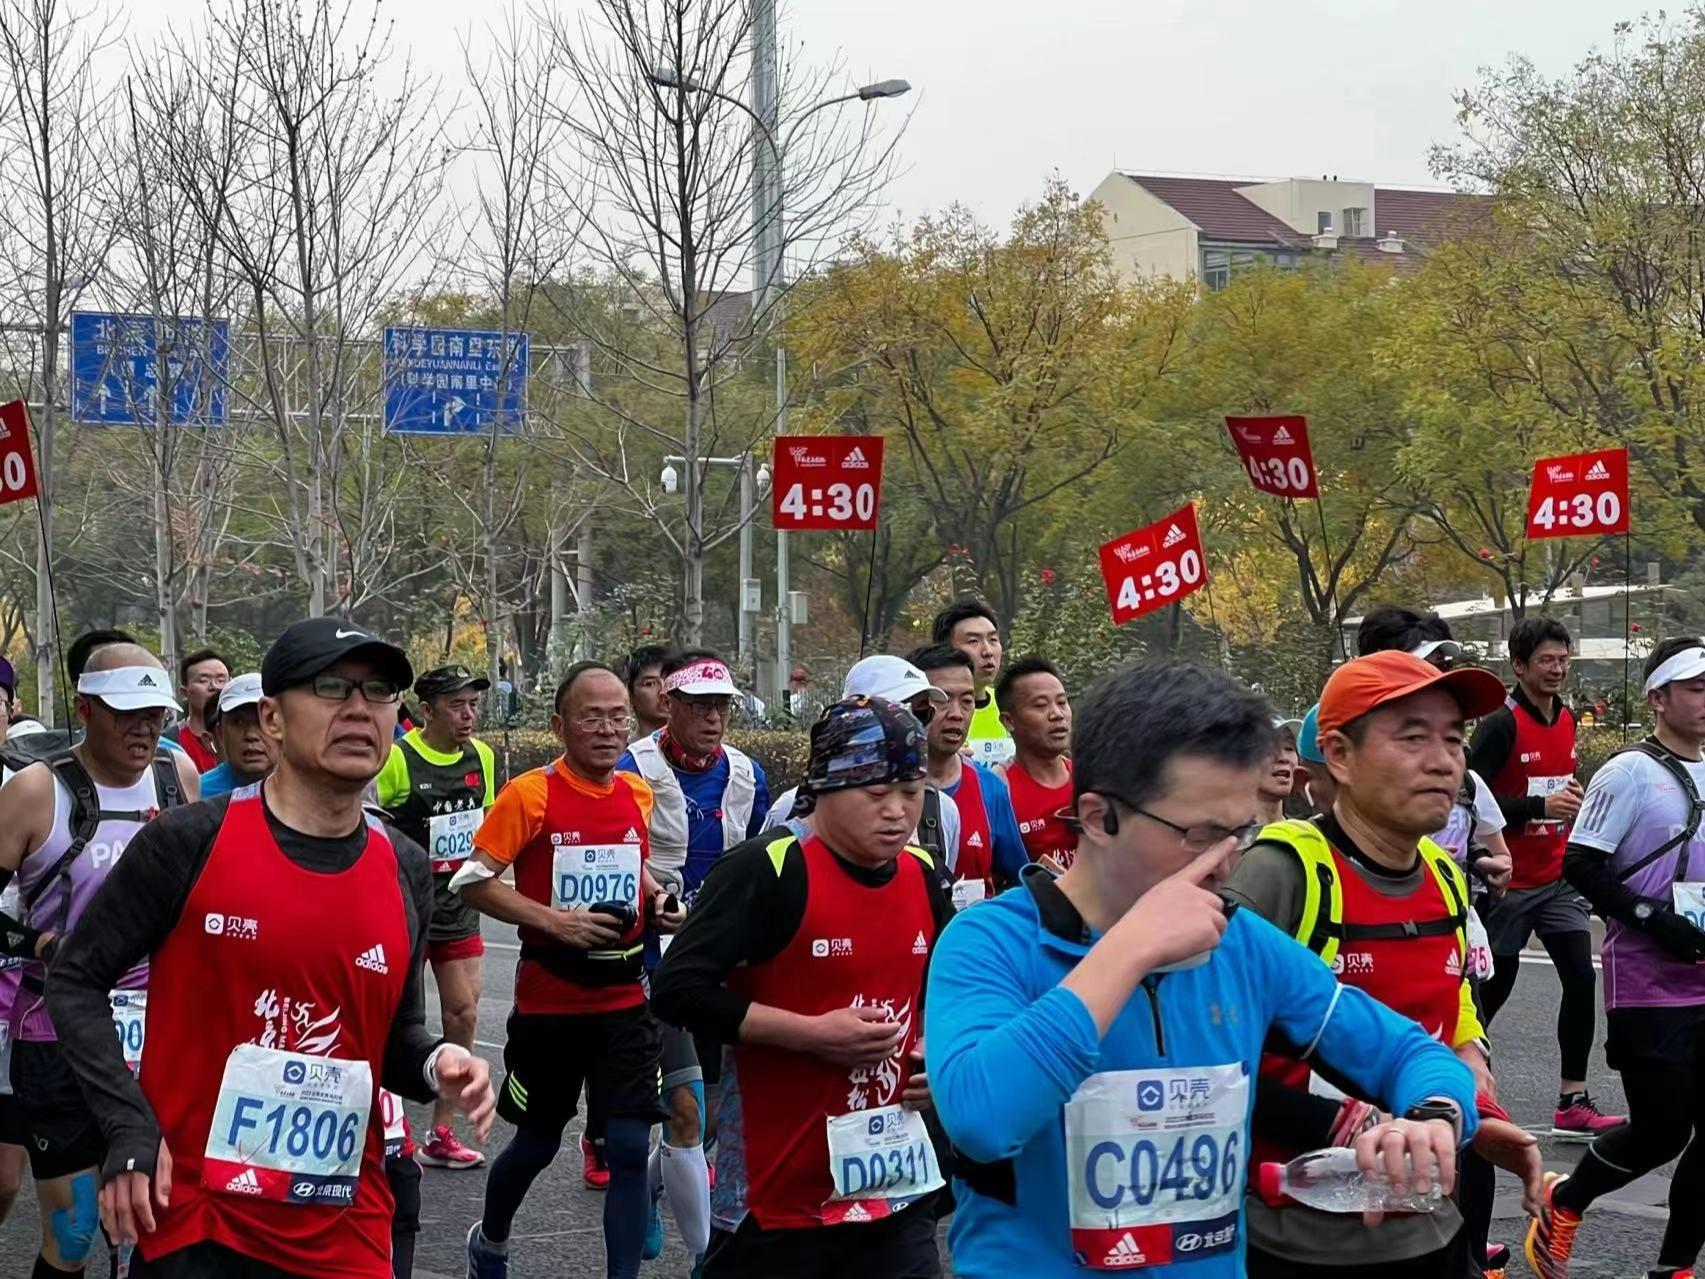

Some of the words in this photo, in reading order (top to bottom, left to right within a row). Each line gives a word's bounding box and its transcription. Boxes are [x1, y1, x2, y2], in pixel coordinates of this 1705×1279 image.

[0, 451, 26, 492] 0
[1249, 455, 1309, 491] 4:30
[779, 483, 874, 521] 4:30
[1533, 491, 1621, 530] 4:30
[1117, 549, 1200, 610] 4:30
[435, 830, 474, 857] C029
[560, 872, 636, 904] D0976
[226, 915, 258, 935] 贝壳
[831, 938, 852, 952] 贝壳
[355, 955, 389, 976] adidas
[1347, 953, 1374, 969] 贝壳
[309, 1063, 343, 1085] 贝壳
[1168, 1078, 1210, 1104] 贝壳
[227, 1096, 359, 1163] F1806
[842, 1143, 928, 1196] D0311
[1085, 1130, 1239, 1210] C0496
[226, 1179, 263, 1196] adidas
[1103, 1253, 1146, 1266] adidas
